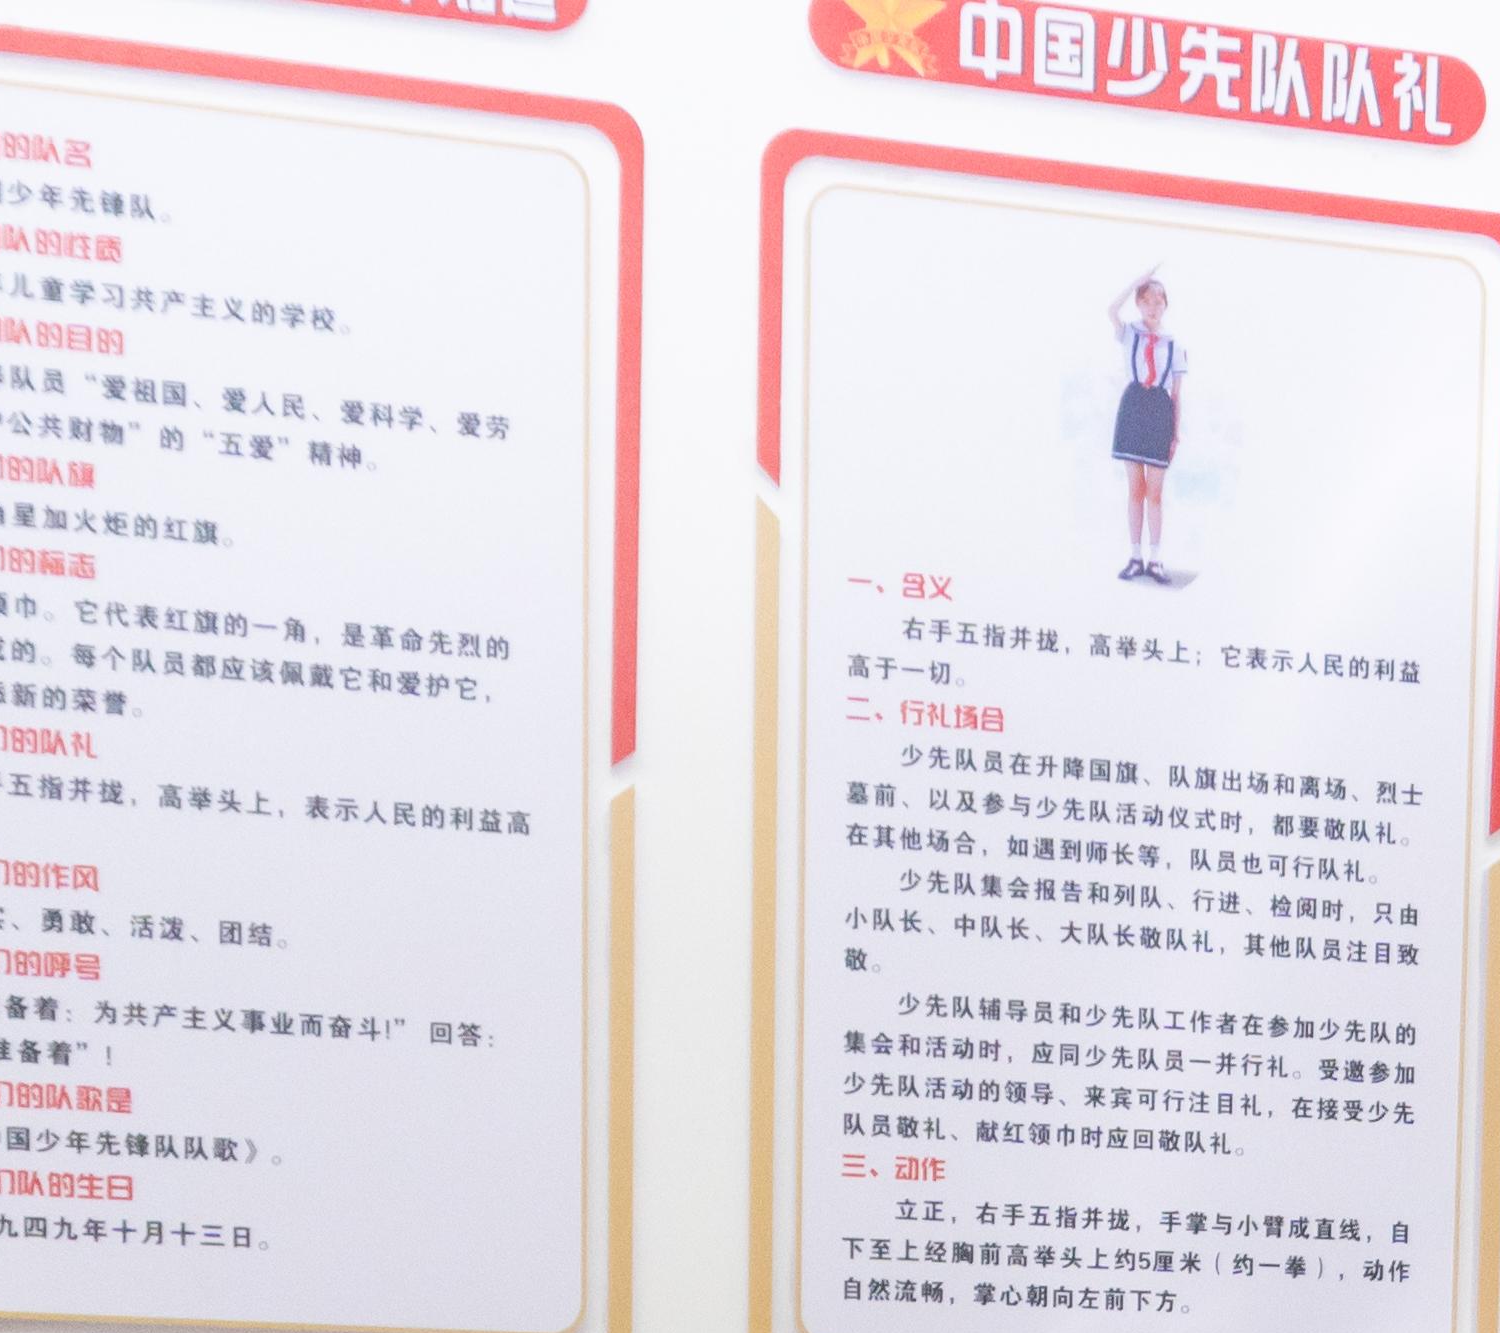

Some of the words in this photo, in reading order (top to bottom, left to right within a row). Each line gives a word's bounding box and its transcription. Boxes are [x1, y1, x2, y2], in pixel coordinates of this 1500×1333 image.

[958, 0, 1454, 137] 中国少先队队礼
[847, 573, 953, 601] 一、含义
[847, 654, 967, 689] 高于一切。
[846, 696, 1005, 733] 二、行礼场合
[844, 947, 882, 973] 敬。
[841, 1154, 946, 1183] 三、动作
